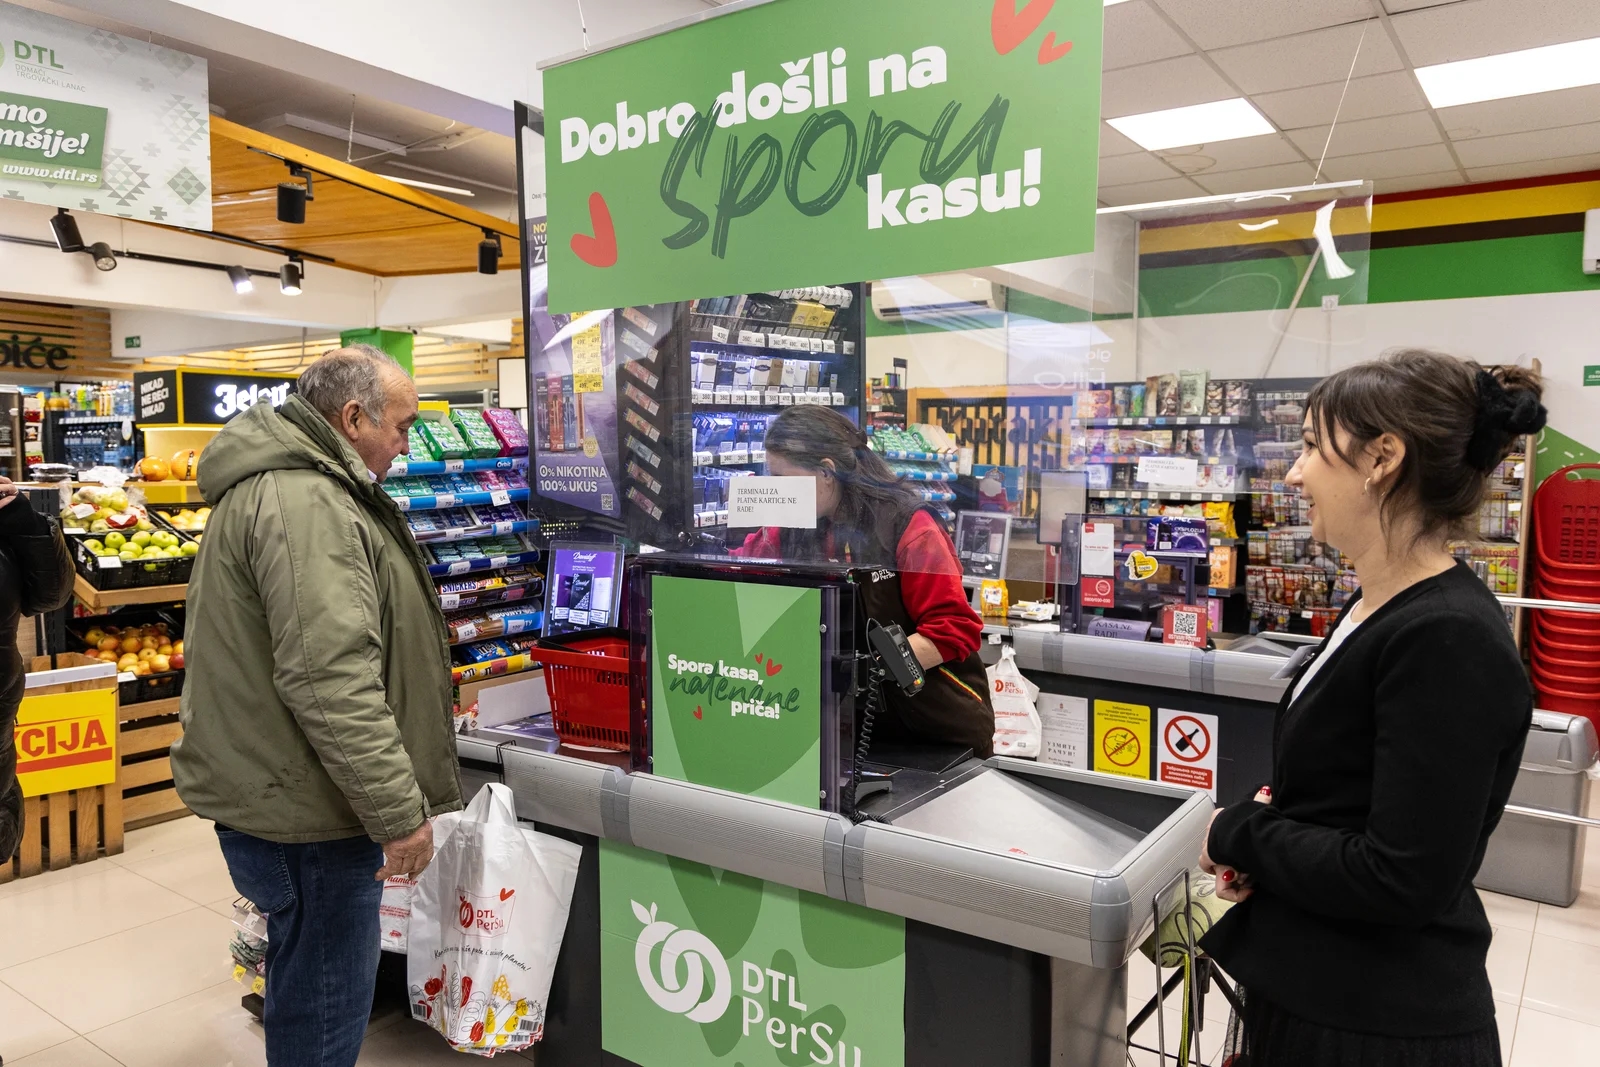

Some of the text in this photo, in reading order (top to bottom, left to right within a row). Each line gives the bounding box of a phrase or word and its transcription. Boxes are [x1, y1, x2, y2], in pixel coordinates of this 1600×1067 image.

[14, 40, 64, 69] DTL
[16, 71, 86, 92] TRGOVAČKI LANAC
[560, 45, 947, 163] Dobro došli na
[3, 164, 98, 183] www.dtl.rs
[867, 147, 1042, 230] kasu!
[140, 377, 164, 394] NIKAD
[141, 387, 169, 406] NE RECI
[141, 402, 165, 418] NIKAD
[497, 460, 511, 468] Orbit
[540, 465, 607, 478] 0% NIKOTINA
[540, 480, 597, 492] 100% UKUS
[443, 580, 477, 592] SNICKERS
[1096, 621, 1118, 630] KASA
[668, 654, 764, 685] Spora kasa,
[669, 661, 800, 712] natenane
[731, 698, 780, 720] priča!
[477, 910, 494, 918] DTL
[477, 919, 503, 930] PerSu
[502, 953, 531, 971] planetu!
[743, 960, 807, 1011] DTL
[743, 996, 861, 1067] PerSu
